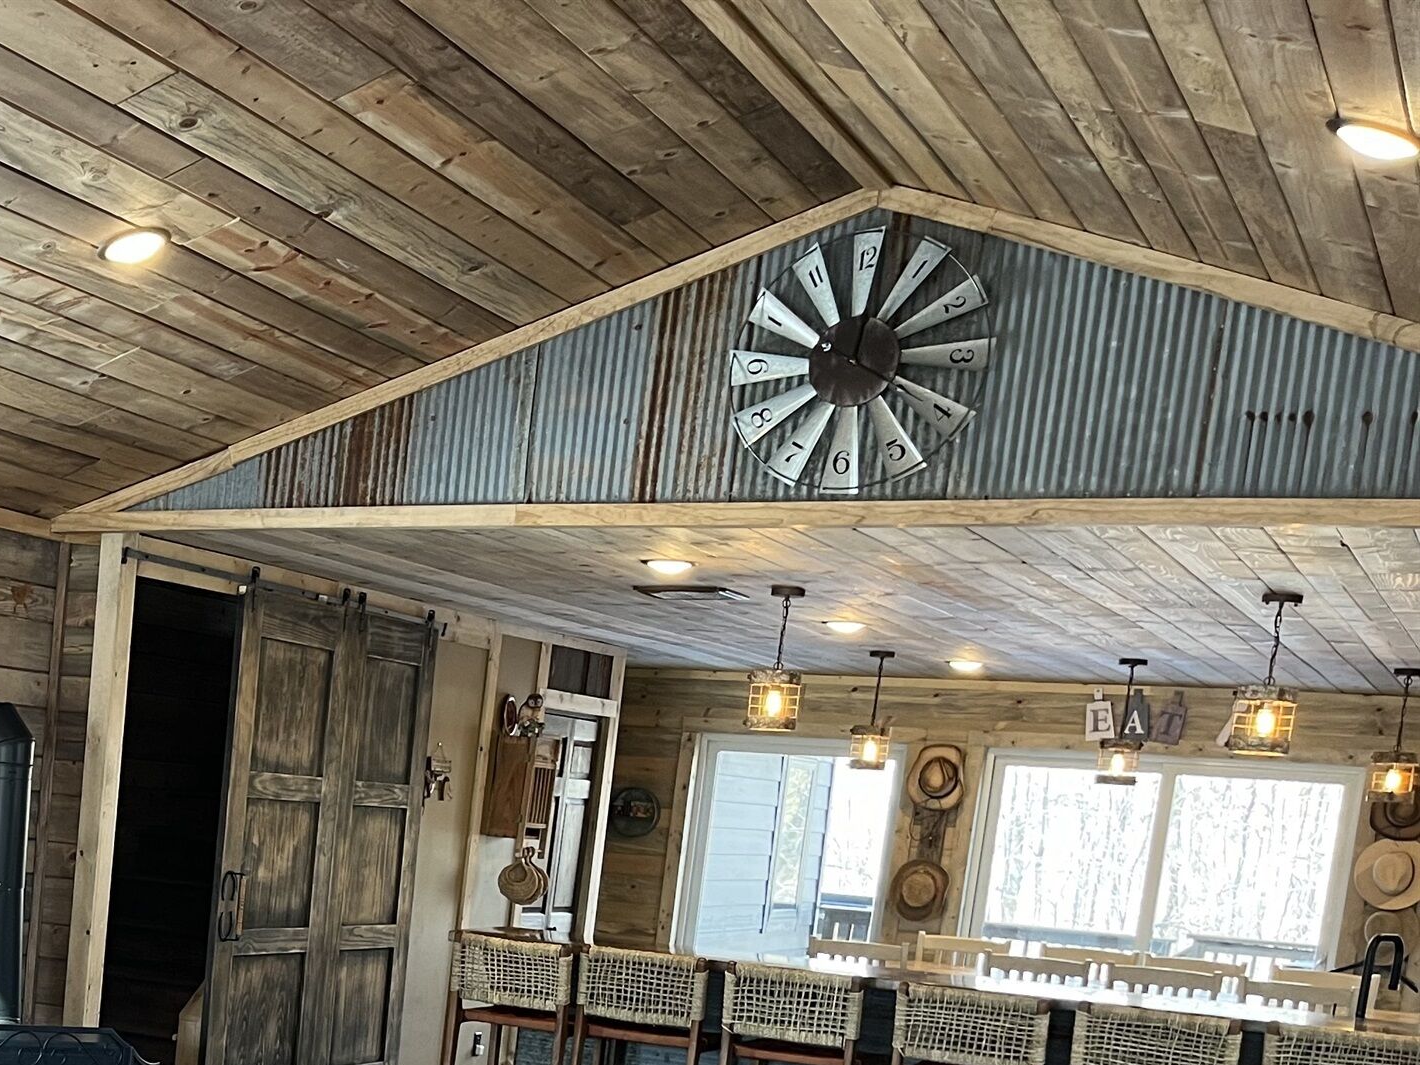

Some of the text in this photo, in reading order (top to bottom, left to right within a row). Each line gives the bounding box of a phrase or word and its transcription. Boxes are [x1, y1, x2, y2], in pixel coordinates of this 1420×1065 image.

[858, 246, 877, 271] 12
[912, 260, 928, 279] 1
[808, 266, 824, 288] 11
[943, 296, 966, 314] 2
[746, 358, 768, 375] 9
[949, 349, 975, 364] 3
[750, 407, 773, 429] 8
[933, 403, 951, 422] 4
[784, 441, 804, 463] 7
[885, 438, 906, 461] 5
[832, 450, 850, 475] 6
